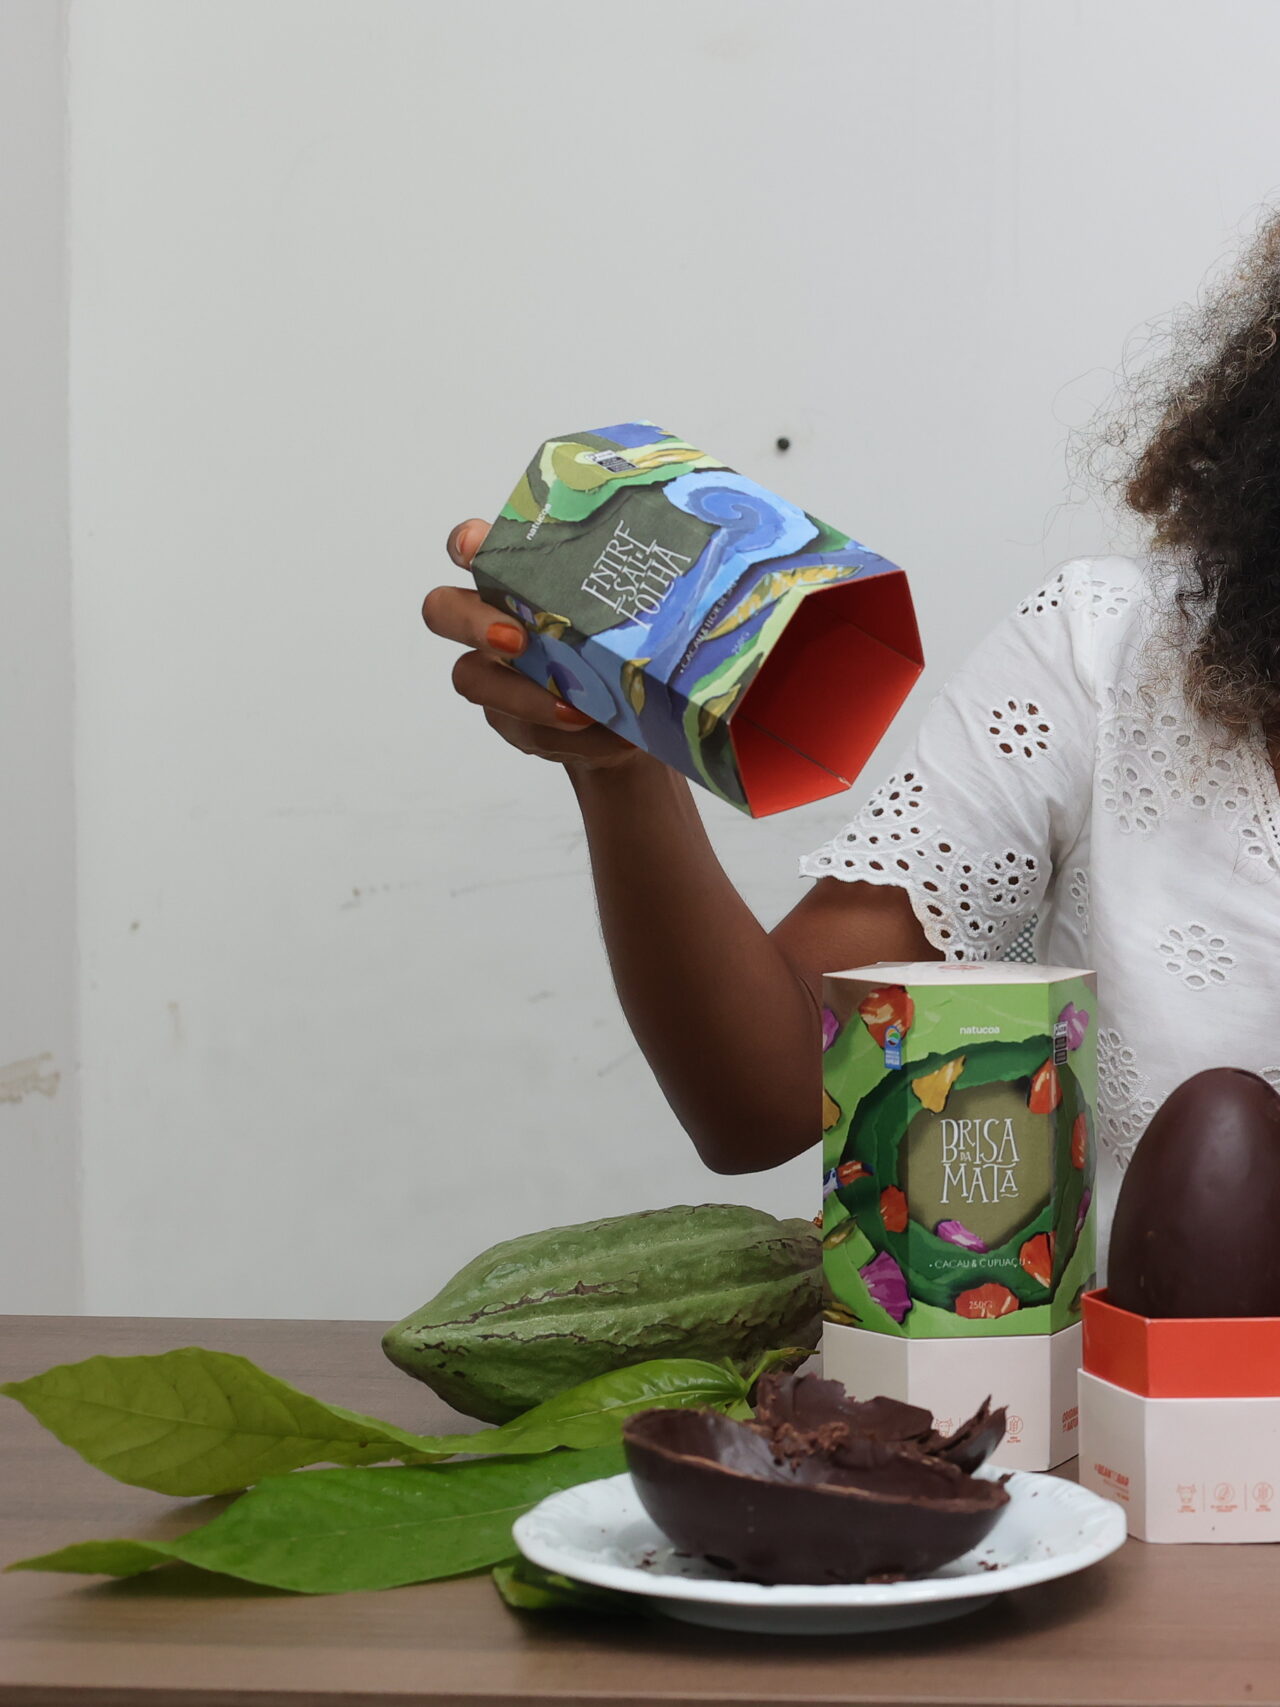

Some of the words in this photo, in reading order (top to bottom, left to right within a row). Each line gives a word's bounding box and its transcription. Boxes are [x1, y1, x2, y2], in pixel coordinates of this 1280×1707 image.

[525, 503, 553, 541] natucoa
[580, 519, 657, 611] ENTRE
[613, 555, 653, 602] SAL
[615, 543, 692, 631] FOLHA
[959, 1025, 1000, 1035] natucoa
[940, 1118, 1020, 1164] BRISA
[960, 1151, 972, 1162] DA
[940, 1162, 1019, 1203] MATA
[934, 1259, 970, 1269] CACAU
[971, 1259, 977, 1268] &
[979, 1257, 1026, 1268] CUPUAÇU
[968, 1300, 993, 1310] 250G
